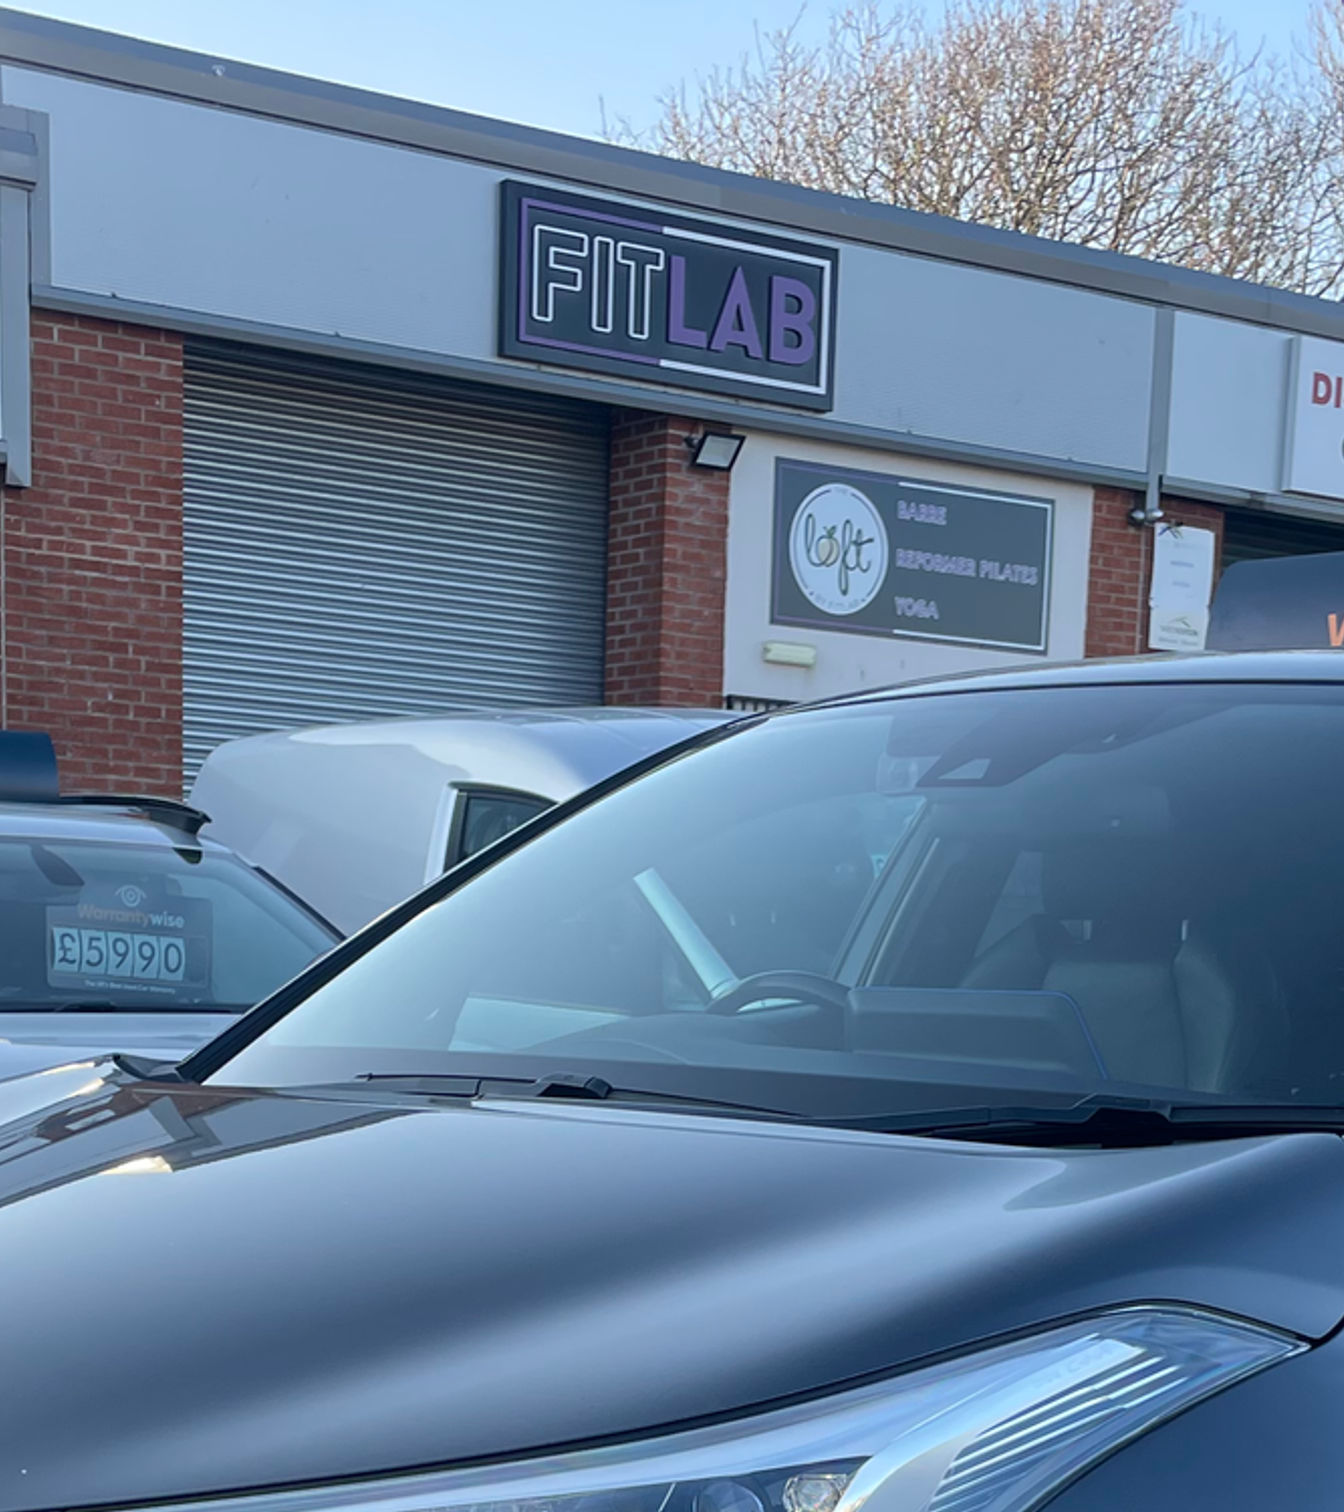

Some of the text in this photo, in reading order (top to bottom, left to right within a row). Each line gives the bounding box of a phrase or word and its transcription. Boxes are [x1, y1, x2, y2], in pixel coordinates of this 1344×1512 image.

[531, 223, 817, 366] FITLAB
[897, 500, 948, 526] BARRE
[895, 548, 1039, 586] REFORMER PILATES
[894, 597, 940, 620] YOGA
[77, 903, 185, 929] Warrantywise
[58, 932, 183, 974] £5990
